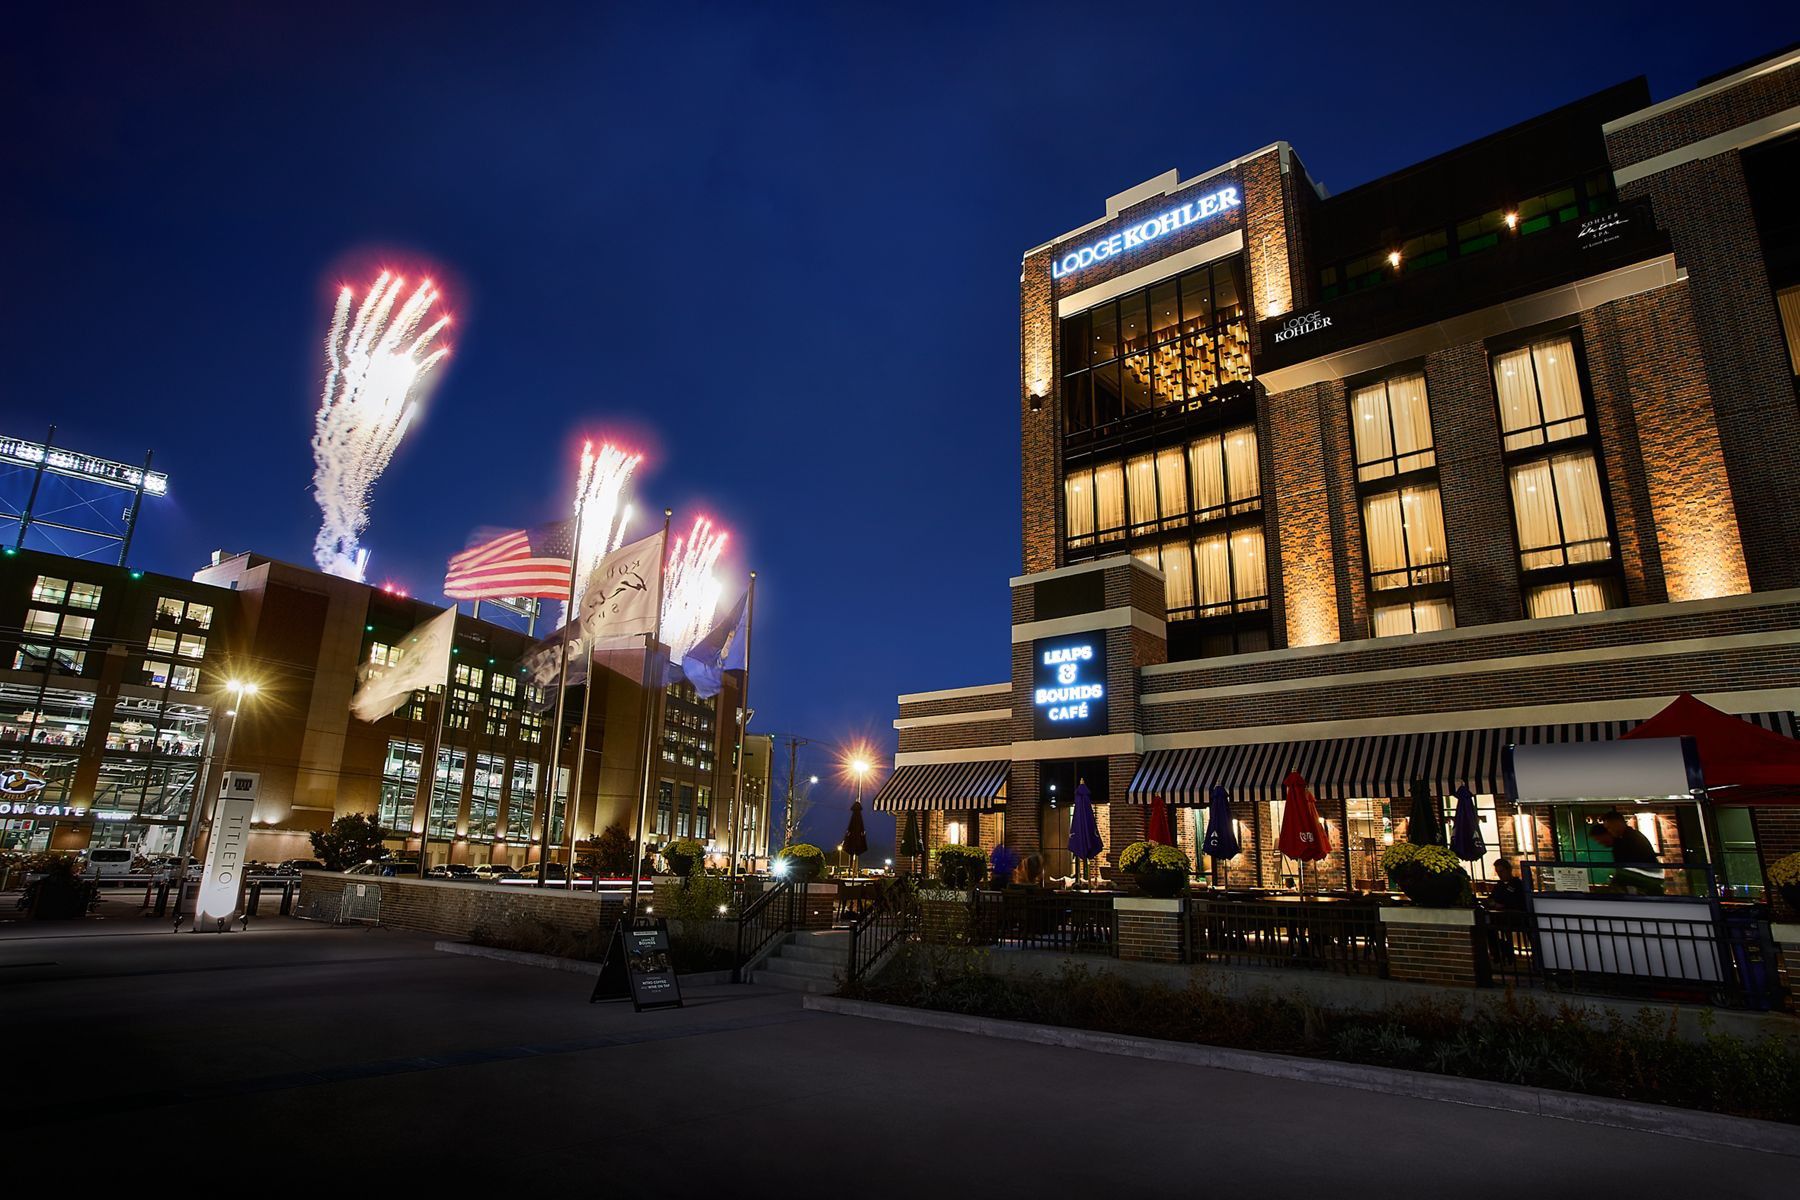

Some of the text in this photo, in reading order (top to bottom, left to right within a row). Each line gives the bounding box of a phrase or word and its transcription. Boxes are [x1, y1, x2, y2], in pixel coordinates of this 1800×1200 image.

[1053, 186, 1241, 279] LODGE KOHLER
[1274, 316, 1333, 343] KOHLER
[1283, 310, 1321, 331] LODGE
[1043, 645, 1093, 665] LEAPS
[1058, 663, 1077, 684] &
[1035, 684, 1103, 704] BOUNDS
[1048, 702, 1089, 721] CAFÉ
[35, 806, 86, 817] GATE
